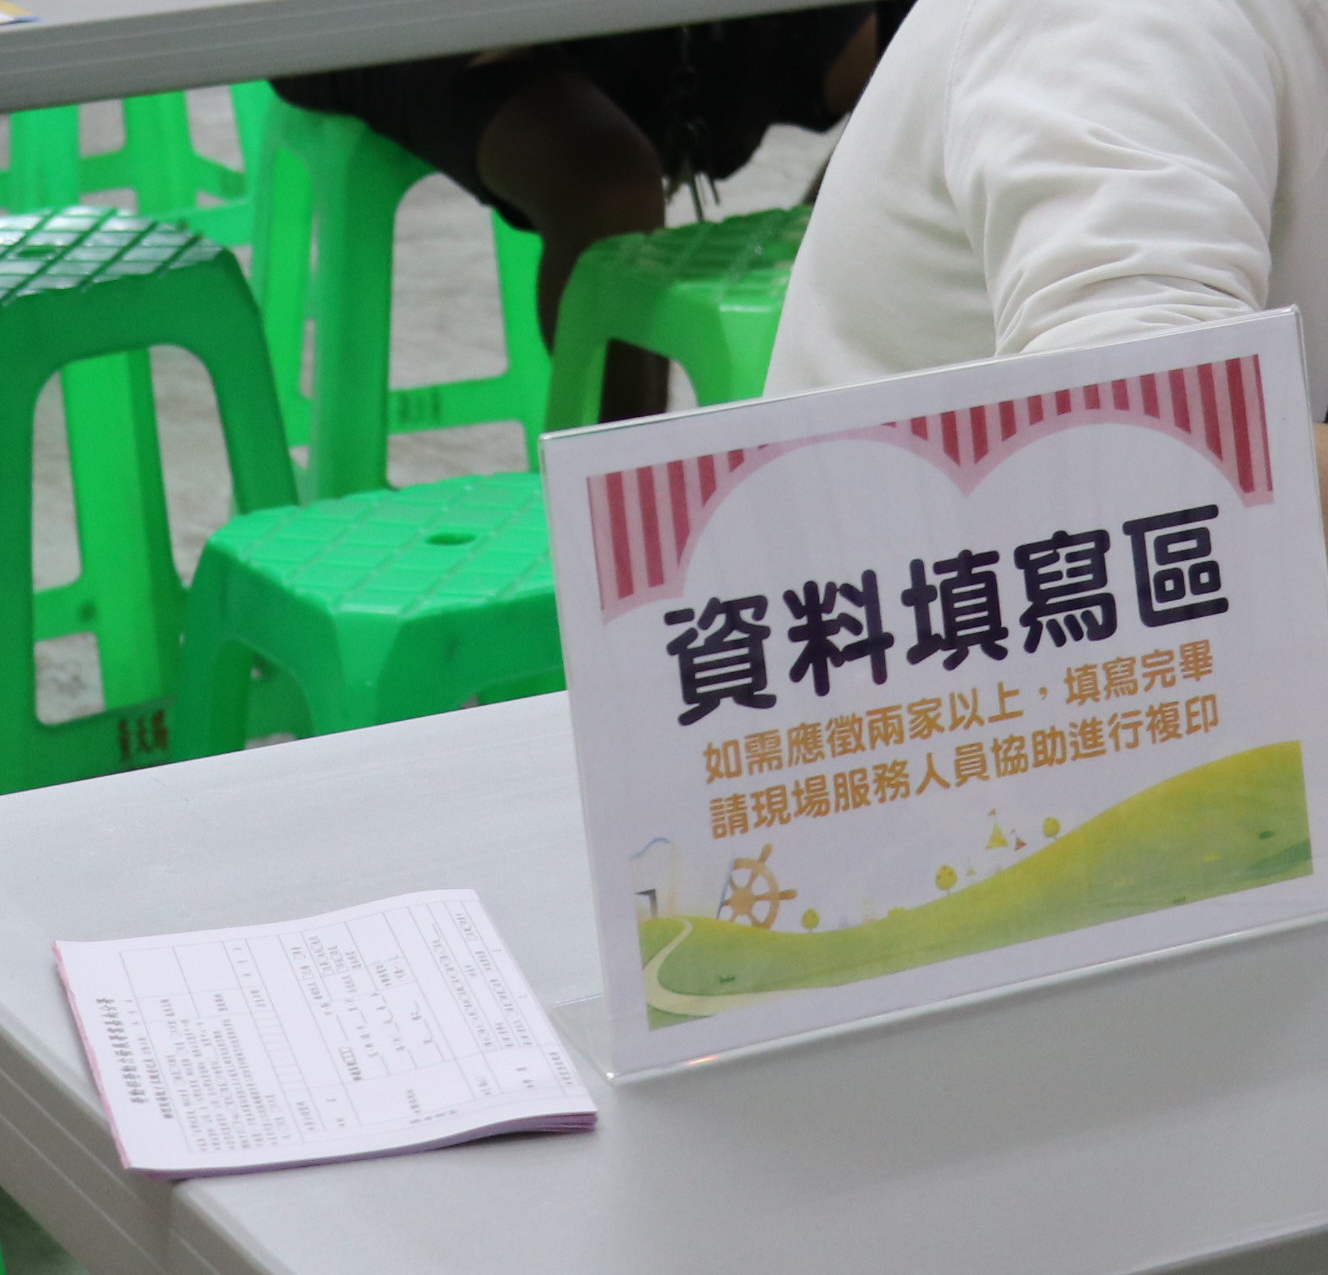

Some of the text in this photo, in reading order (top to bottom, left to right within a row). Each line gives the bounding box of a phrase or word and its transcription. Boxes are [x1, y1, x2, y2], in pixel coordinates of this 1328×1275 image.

[665, 504, 1229, 727] 資料填寫區
[702, 639, 1215, 785] 如需應徵兩家以上,填寫完畢
[709, 693, 1220, 840] 請現場服務人員協助進行複印
